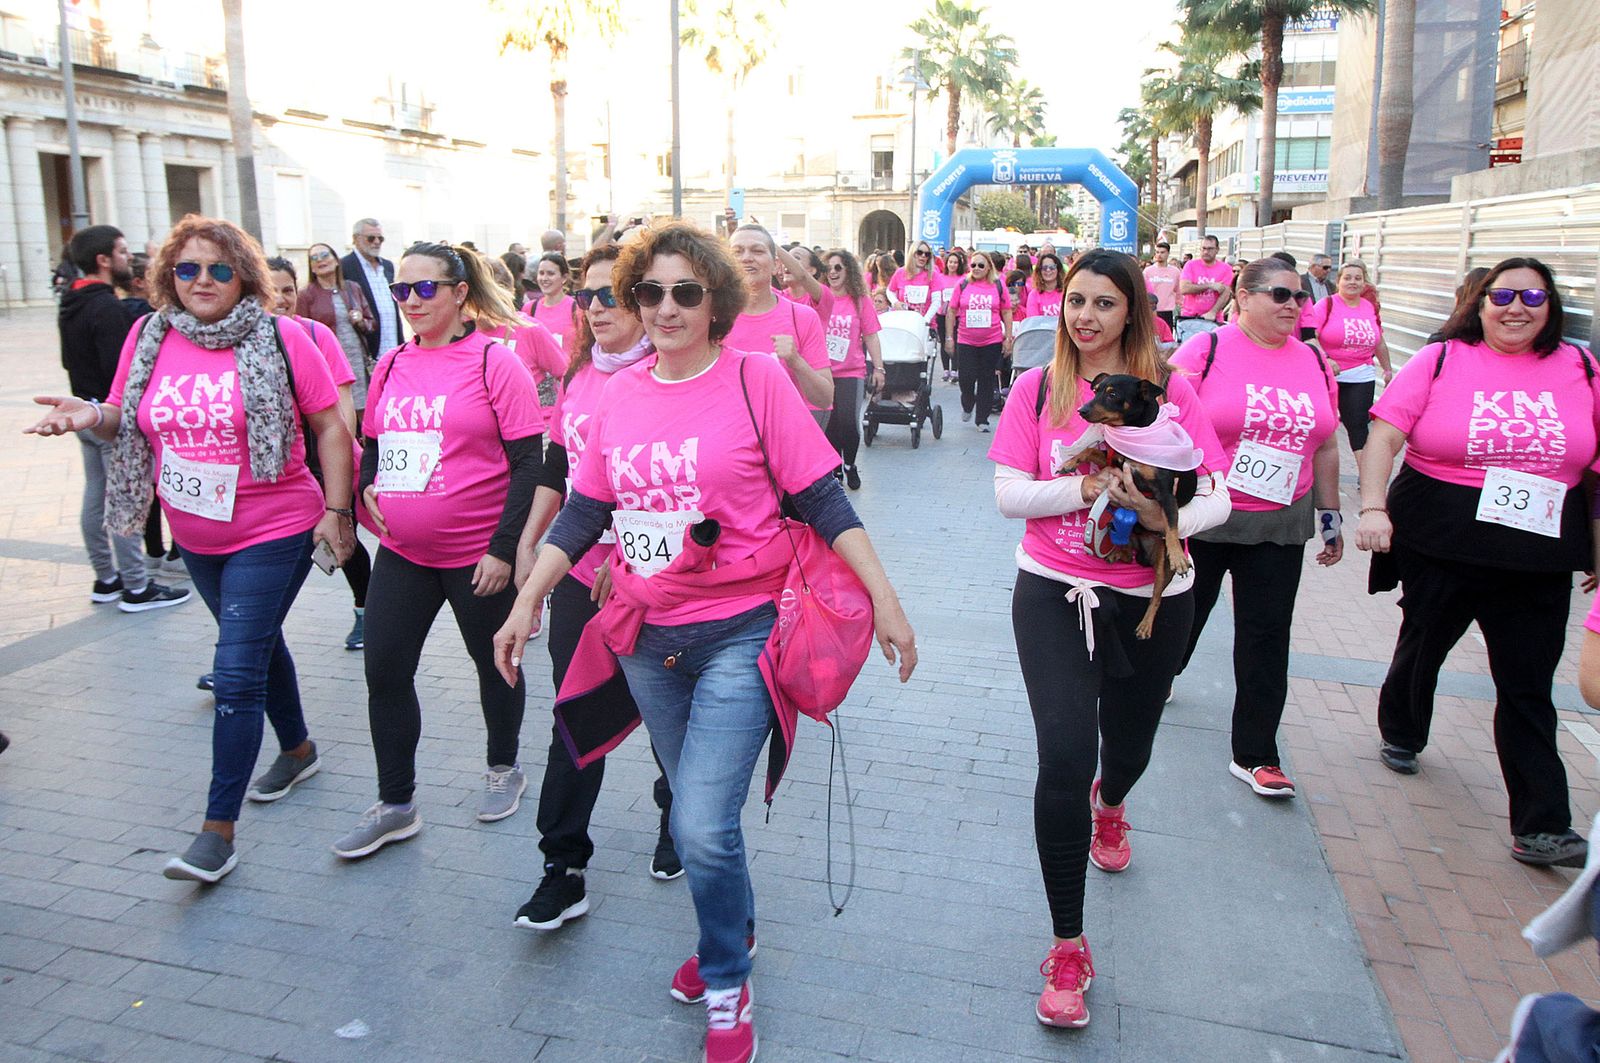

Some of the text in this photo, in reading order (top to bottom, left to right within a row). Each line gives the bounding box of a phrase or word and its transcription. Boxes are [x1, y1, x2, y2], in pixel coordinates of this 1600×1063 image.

[932, 164, 966, 197] DEPORTES
[1019, 173, 1062, 181] HUELVA
[1088, 163, 1121, 196] DEPORTES
[970, 293, 993, 305] KM
[1344, 318, 1373, 331] KM
[1345, 329, 1376, 340] POR
[151, 371, 235, 406] KM
[1245, 383, 1315, 417] KM
[151, 403, 235, 431] POR
[384, 395, 447, 429] KM
[1472, 390, 1559, 418] KM
[1243, 408, 1316, 436] POR
[1468, 418, 1567, 440] POR
[160, 429, 238, 449] ELLAS
[1239, 429, 1307, 451] ELLAS
[1466, 438, 1567, 456] ELLAS
[379, 449, 408, 471] 683
[611, 437, 699, 491] KM
[1235, 454, 1282, 482] 807
[162, 464, 202, 497] 833
[616, 485, 701, 513] POR
[1494, 485, 1530, 510] 33
[665, 520, 674, 529] la
[623, 531, 672, 562] 834
